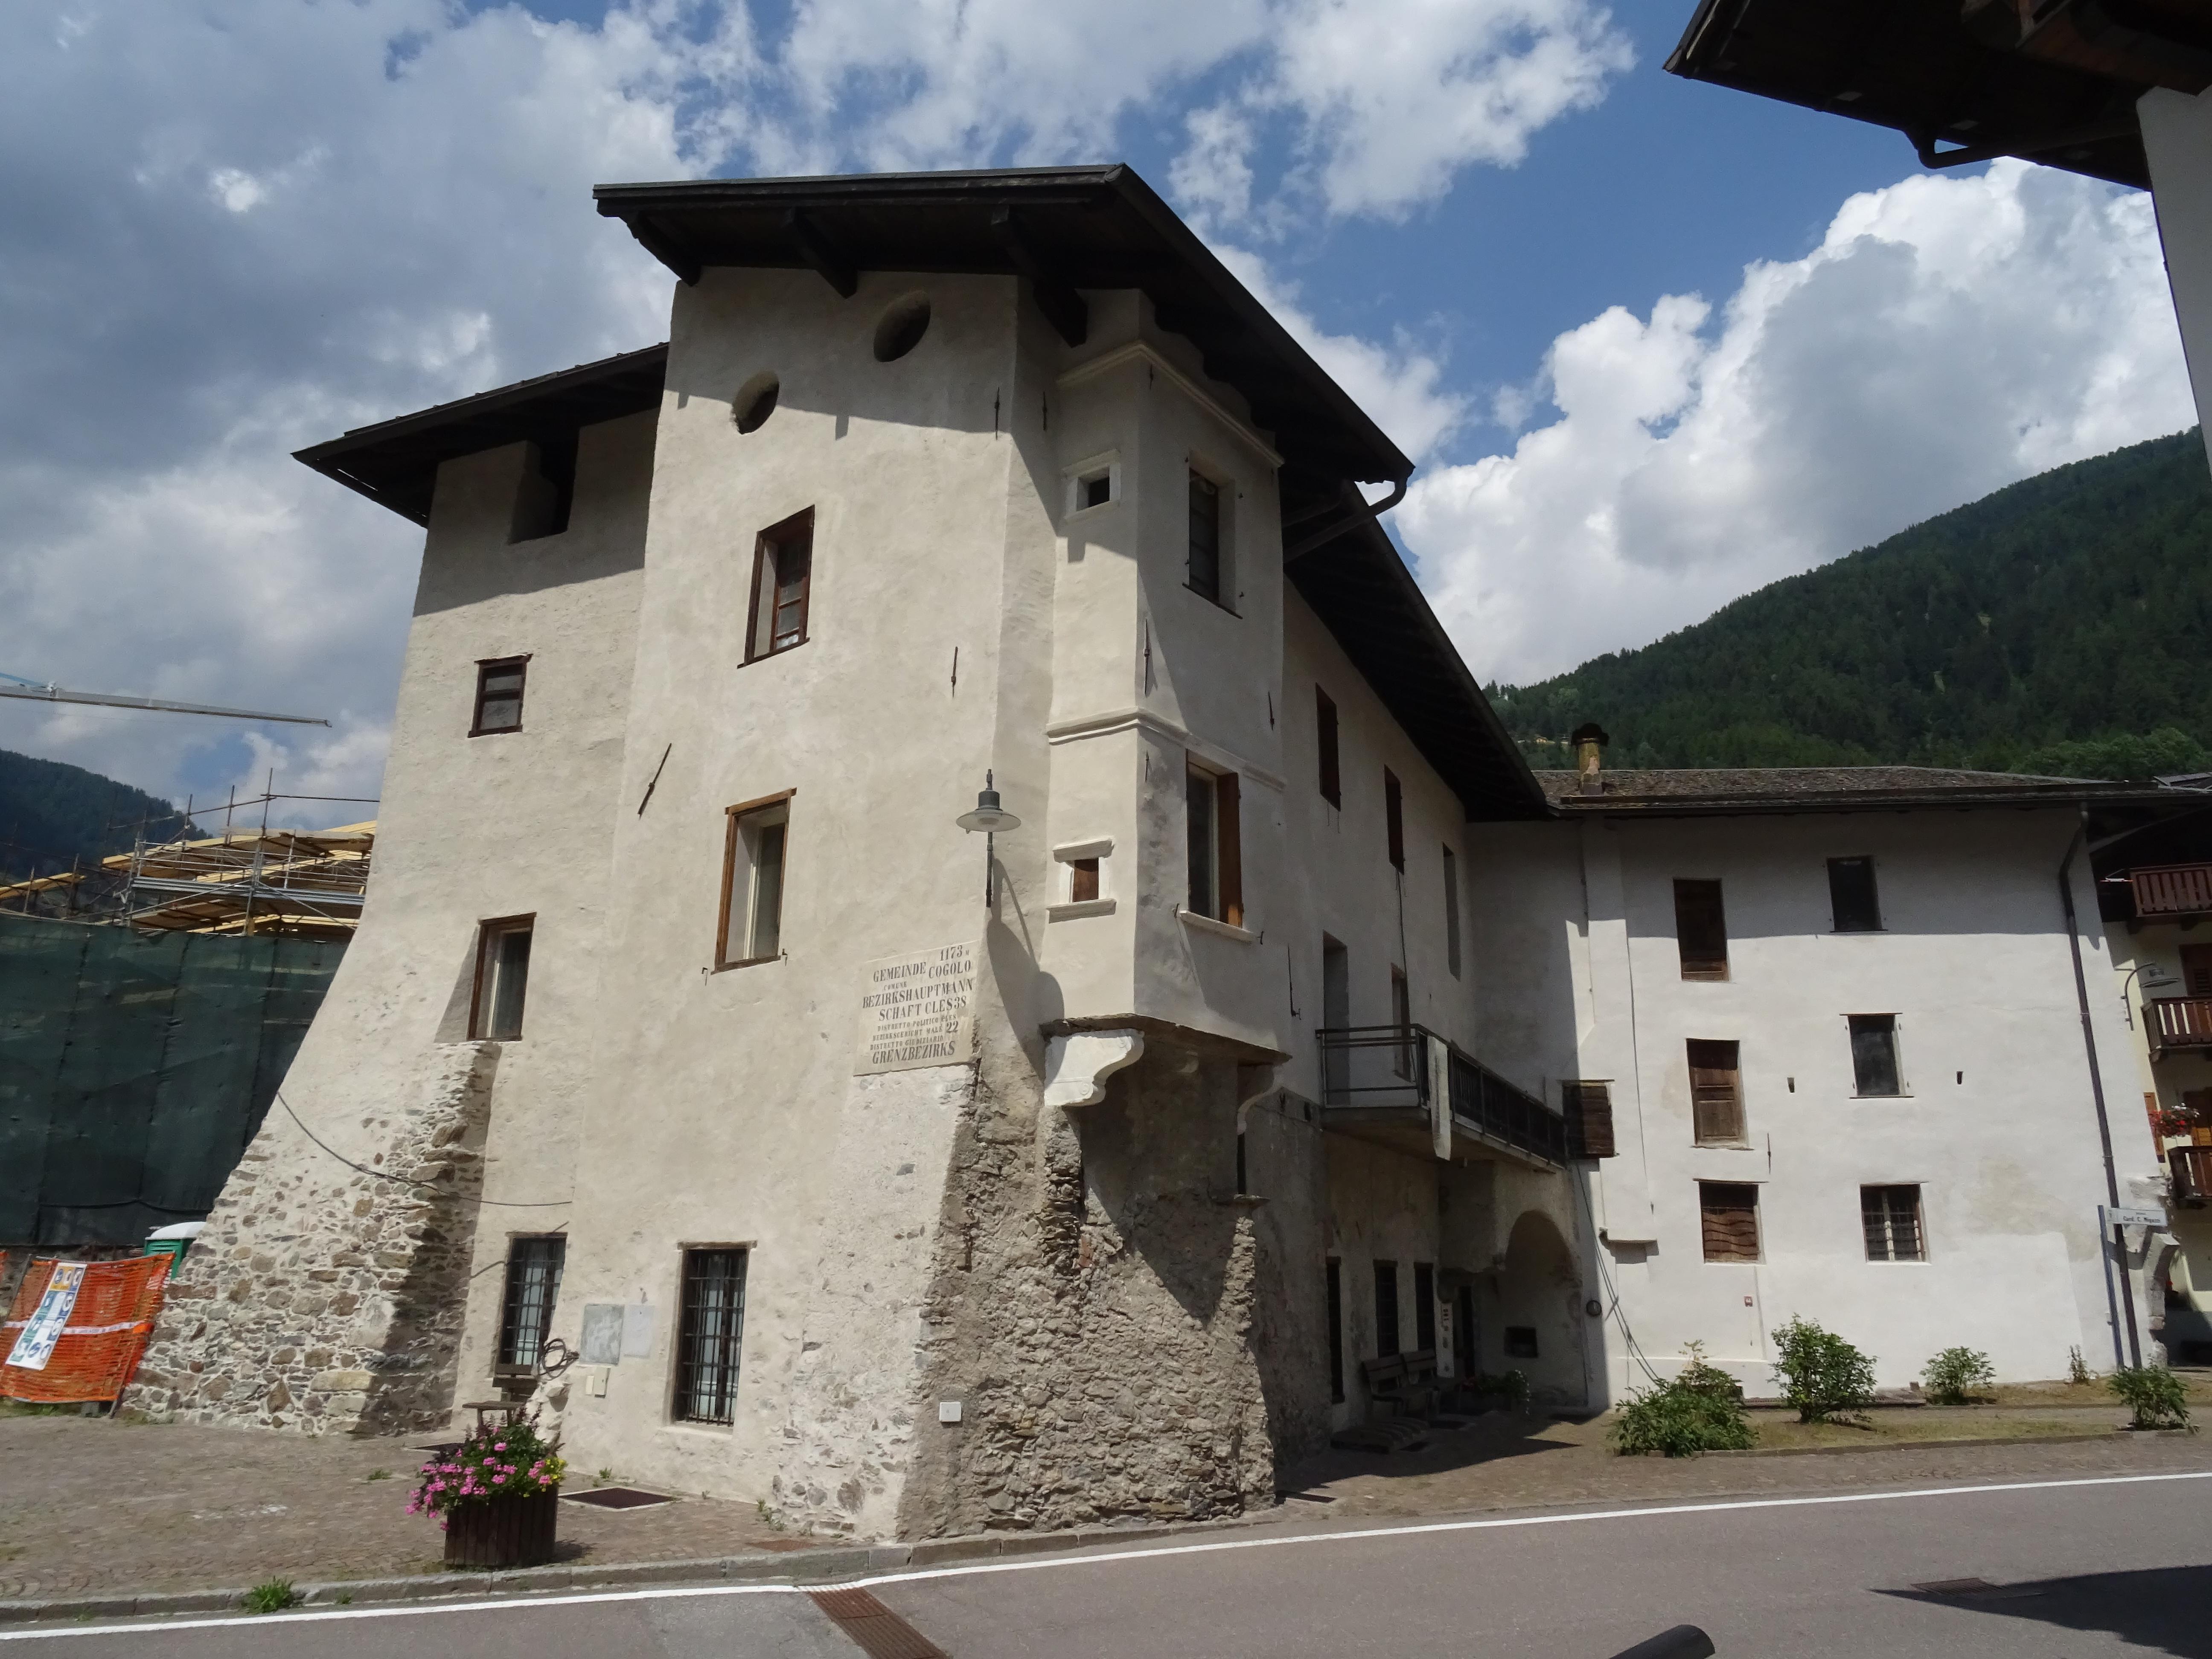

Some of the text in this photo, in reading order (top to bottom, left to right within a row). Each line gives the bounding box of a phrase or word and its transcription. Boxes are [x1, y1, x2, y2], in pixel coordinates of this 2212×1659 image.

[940, 945, 963, 961] 1173
[873, 960, 971, 982] GEMEINDE COGOLO
[862, 978, 974, 1008] BEZIRKSHAUPTMANN
[884, 981, 907, 990] COMUNE
[879, 1003, 922, 1021] SCHAFT
[877, 1022, 910, 1032] DISTRETTO
[913, 1017, 938, 1027] POLITICO
[946, 1021, 959, 1033] 22
[870, 1035, 943, 1050] DISTRETTO GIUDIZIARIO
[873, 1040, 955, 1064] GRENZBEZIRKS
